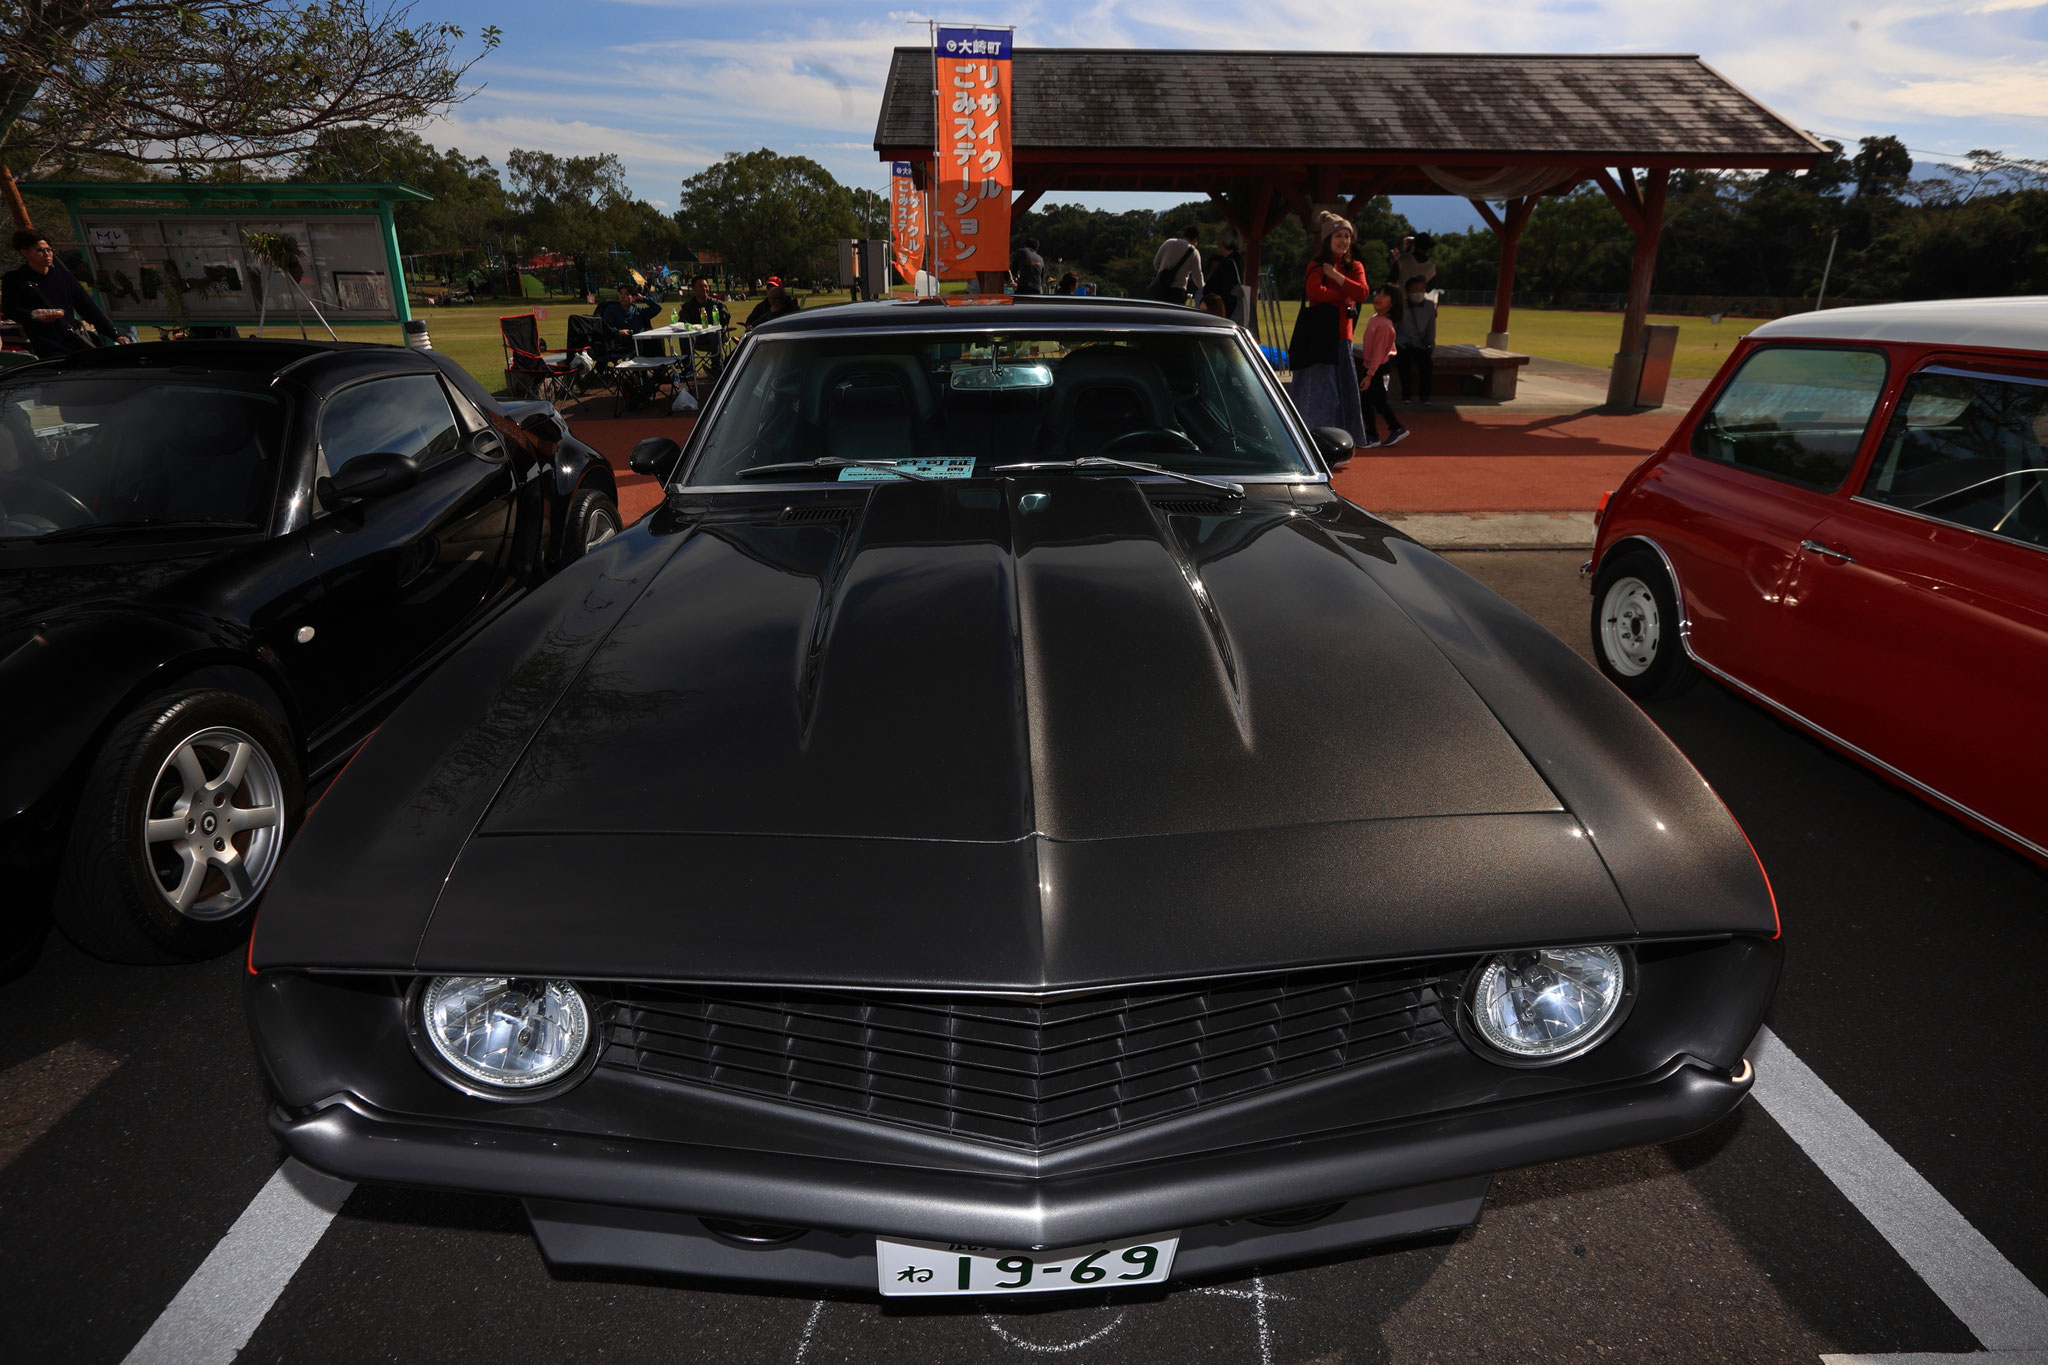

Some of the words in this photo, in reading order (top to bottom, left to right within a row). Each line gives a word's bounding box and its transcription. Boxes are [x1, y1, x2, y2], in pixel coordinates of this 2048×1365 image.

[958, 39, 1002, 55] 大崎町
[978, 64, 1001, 200] リサイクル
[952, 63, 979, 261] ごみステーション
[96, 231, 121, 240] トイレ
[897, 1265, 934, 1283] ね
[958, 1245, 1159, 1290] 19-69
